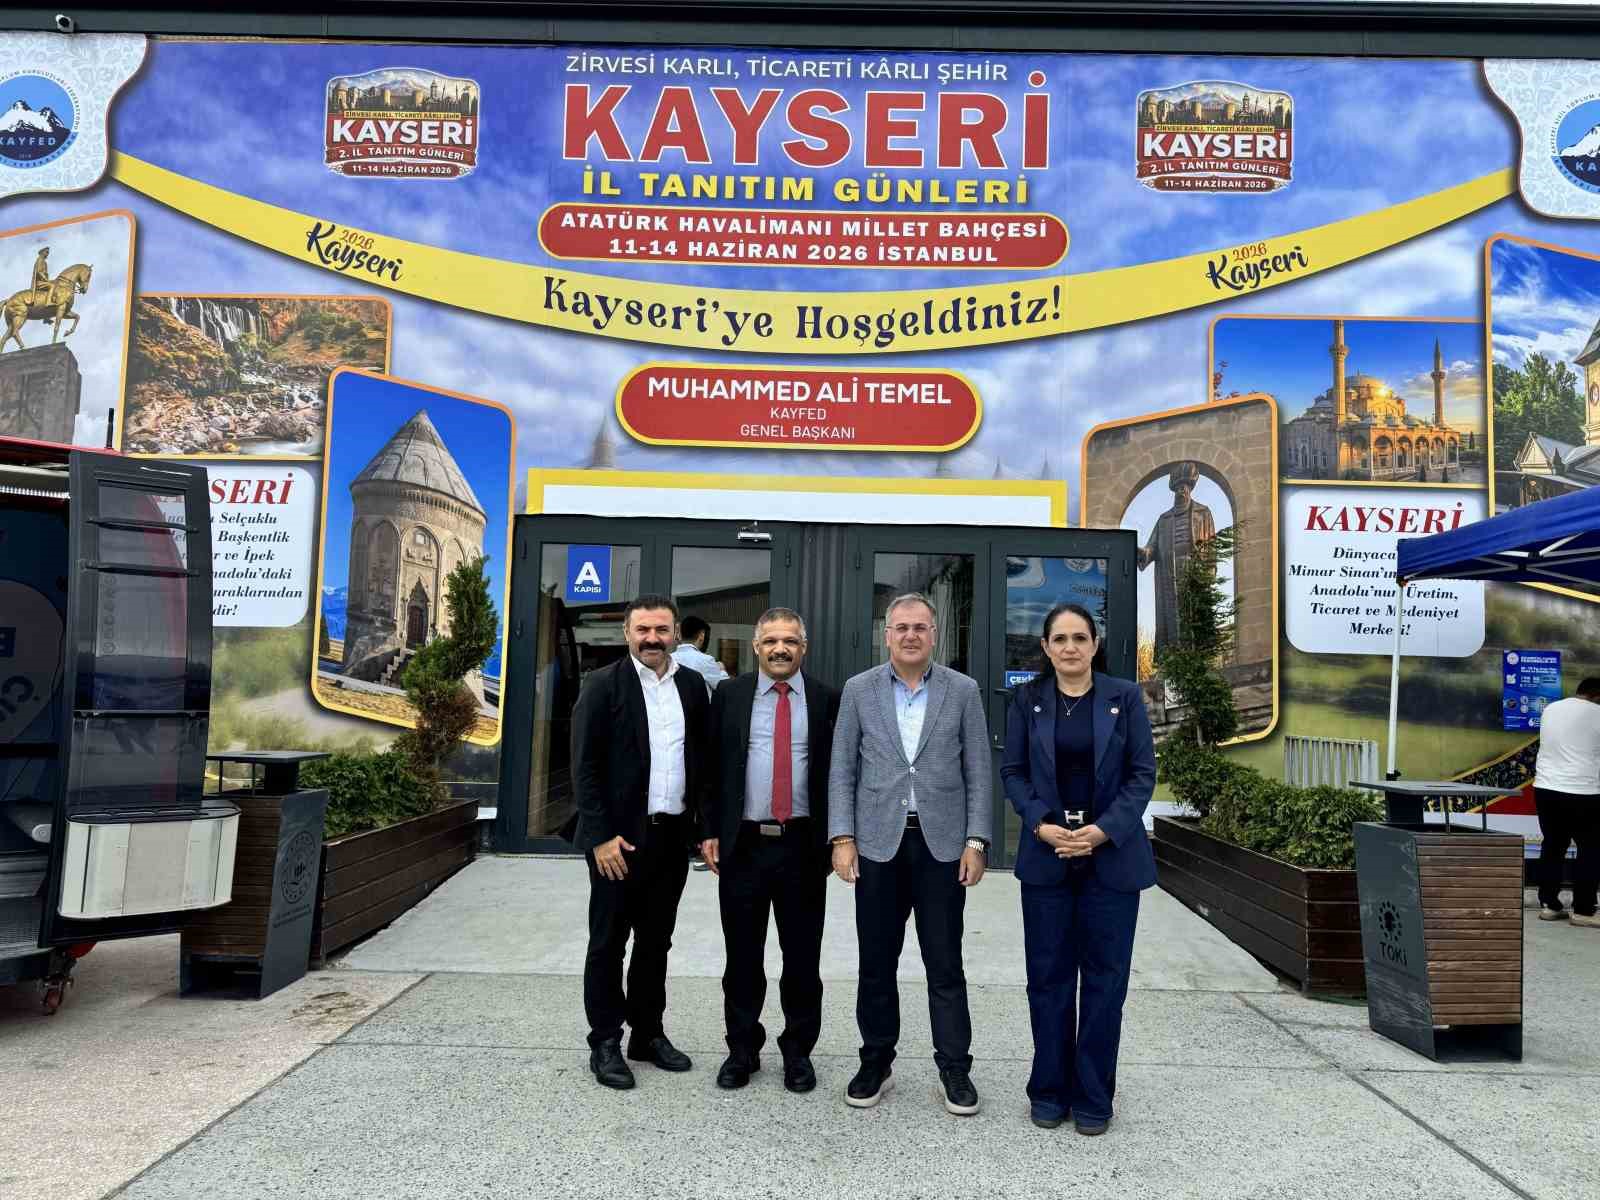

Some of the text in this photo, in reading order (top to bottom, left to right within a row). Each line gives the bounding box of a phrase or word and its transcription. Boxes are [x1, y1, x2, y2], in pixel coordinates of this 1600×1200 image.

[566, 52, 1008, 85] ZİRVESİ KARLI, TİCARETİ KÂRLI ŞEHİR
[562, 70, 1050, 170] KAYSERİ
[332, 118, 473, 145] KAYSERİ
[339, 147, 464, 161] 2. İL TANITIM GÜNLERİ
[1143, 132, 1287, 159] KAYSERİ
[382, 164, 427, 174] HAZİRAN
[431, 166, 451, 174] 2026
[1151, 161, 1279, 174] 2. İL TANITIM GÜNLERİ
[583, 165, 1029, 204] İL TANITIM GÜNLERİ
[1195, 178, 1242, 188] HAZİRAN
[561, 211, 1047, 241] ATATÜRK HAVALİMANI MİLLET BAHÇESİ
[341, 229, 375, 250] 2026
[306, 222, 403, 282] Kayseri
[609, 239, 998, 262] 11-14 HAZİRAN 2026 İSTANBUL
[1232, 242, 1267, 261] 2026
[1205, 246, 1309, 291] Kayseri
[796, 285, 1060, 348] Hoşgeldiniz!
[648, 376, 951, 405] MUHAMMED ALİ TEMEL
[770, 407, 826, 421] KAYFED
[740, 424, 855, 441] GENEL BAŞKANI
[208, 472, 295, 505] SERİ
[219, 511, 277, 526] Selçuklu
[1304, 501, 1465, 534] KAYSERİ
[216, 530, 290, 545] Başkentlik
[224, 552, 239, 561] ve
[243, 546, 275, 563] İpek
[1333, 547, 1396, 561] Dünyaca
[574, 561, 601, 585] A
[1288, 565, 1335, 577] Mimar
[213, 585, 303, 598] uraklarından
[1406, 583, 1458, 600] Üretim,
[1310, 602, 1360, 616] Ticaret
[1366, 607, 1380, 616] ve
[1349, 622, 1411, 636] Merkei!
